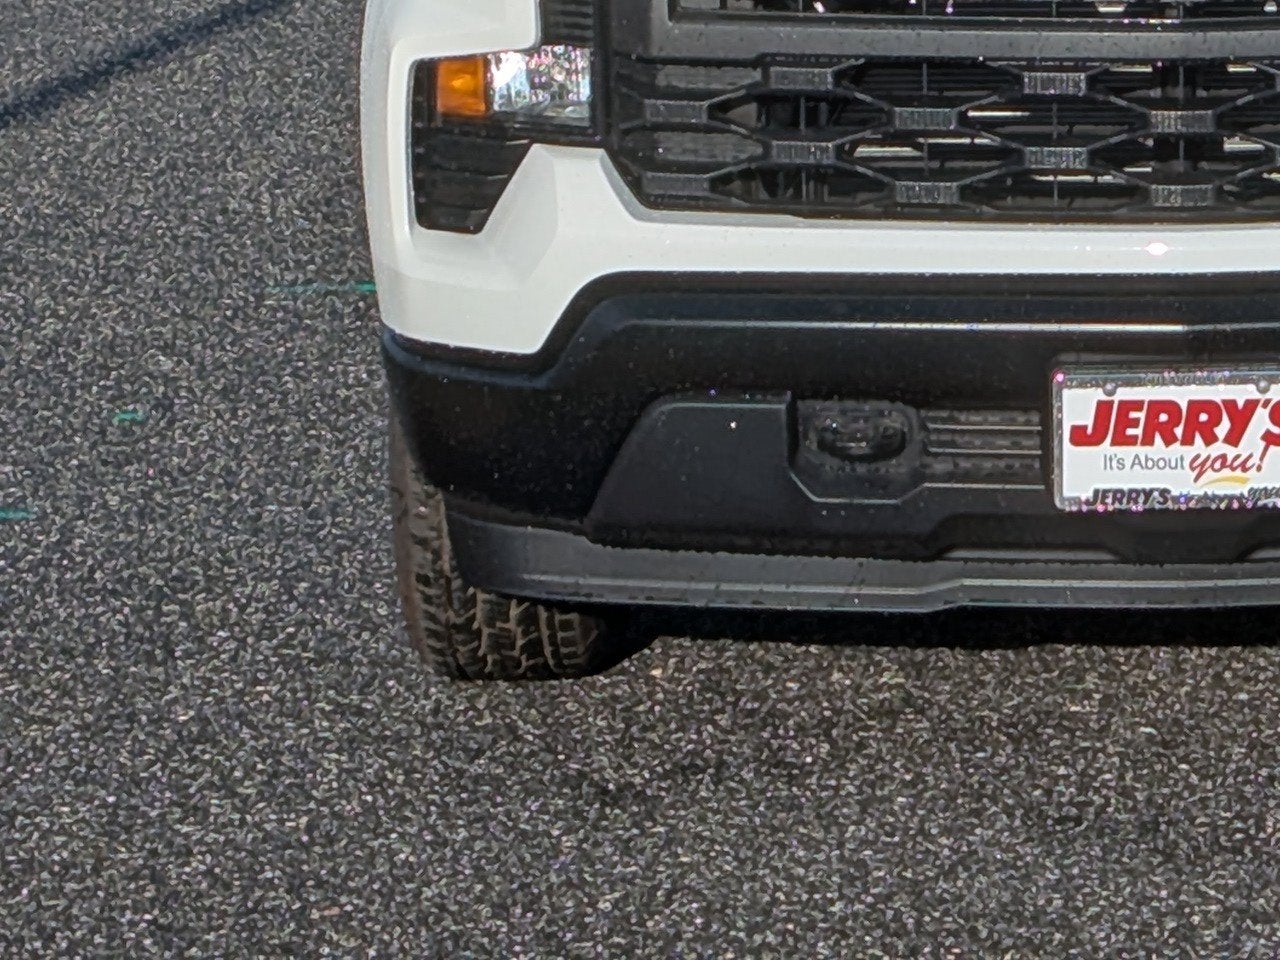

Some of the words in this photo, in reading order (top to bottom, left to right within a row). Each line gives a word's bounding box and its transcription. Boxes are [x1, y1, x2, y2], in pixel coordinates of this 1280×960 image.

[1103, 454, 1125, 471] It's
[1130, 453, 1185, 471] About
[1188, 444, 1270, 483] you!
[1086, 488, 1172, 506] JERRY'S
